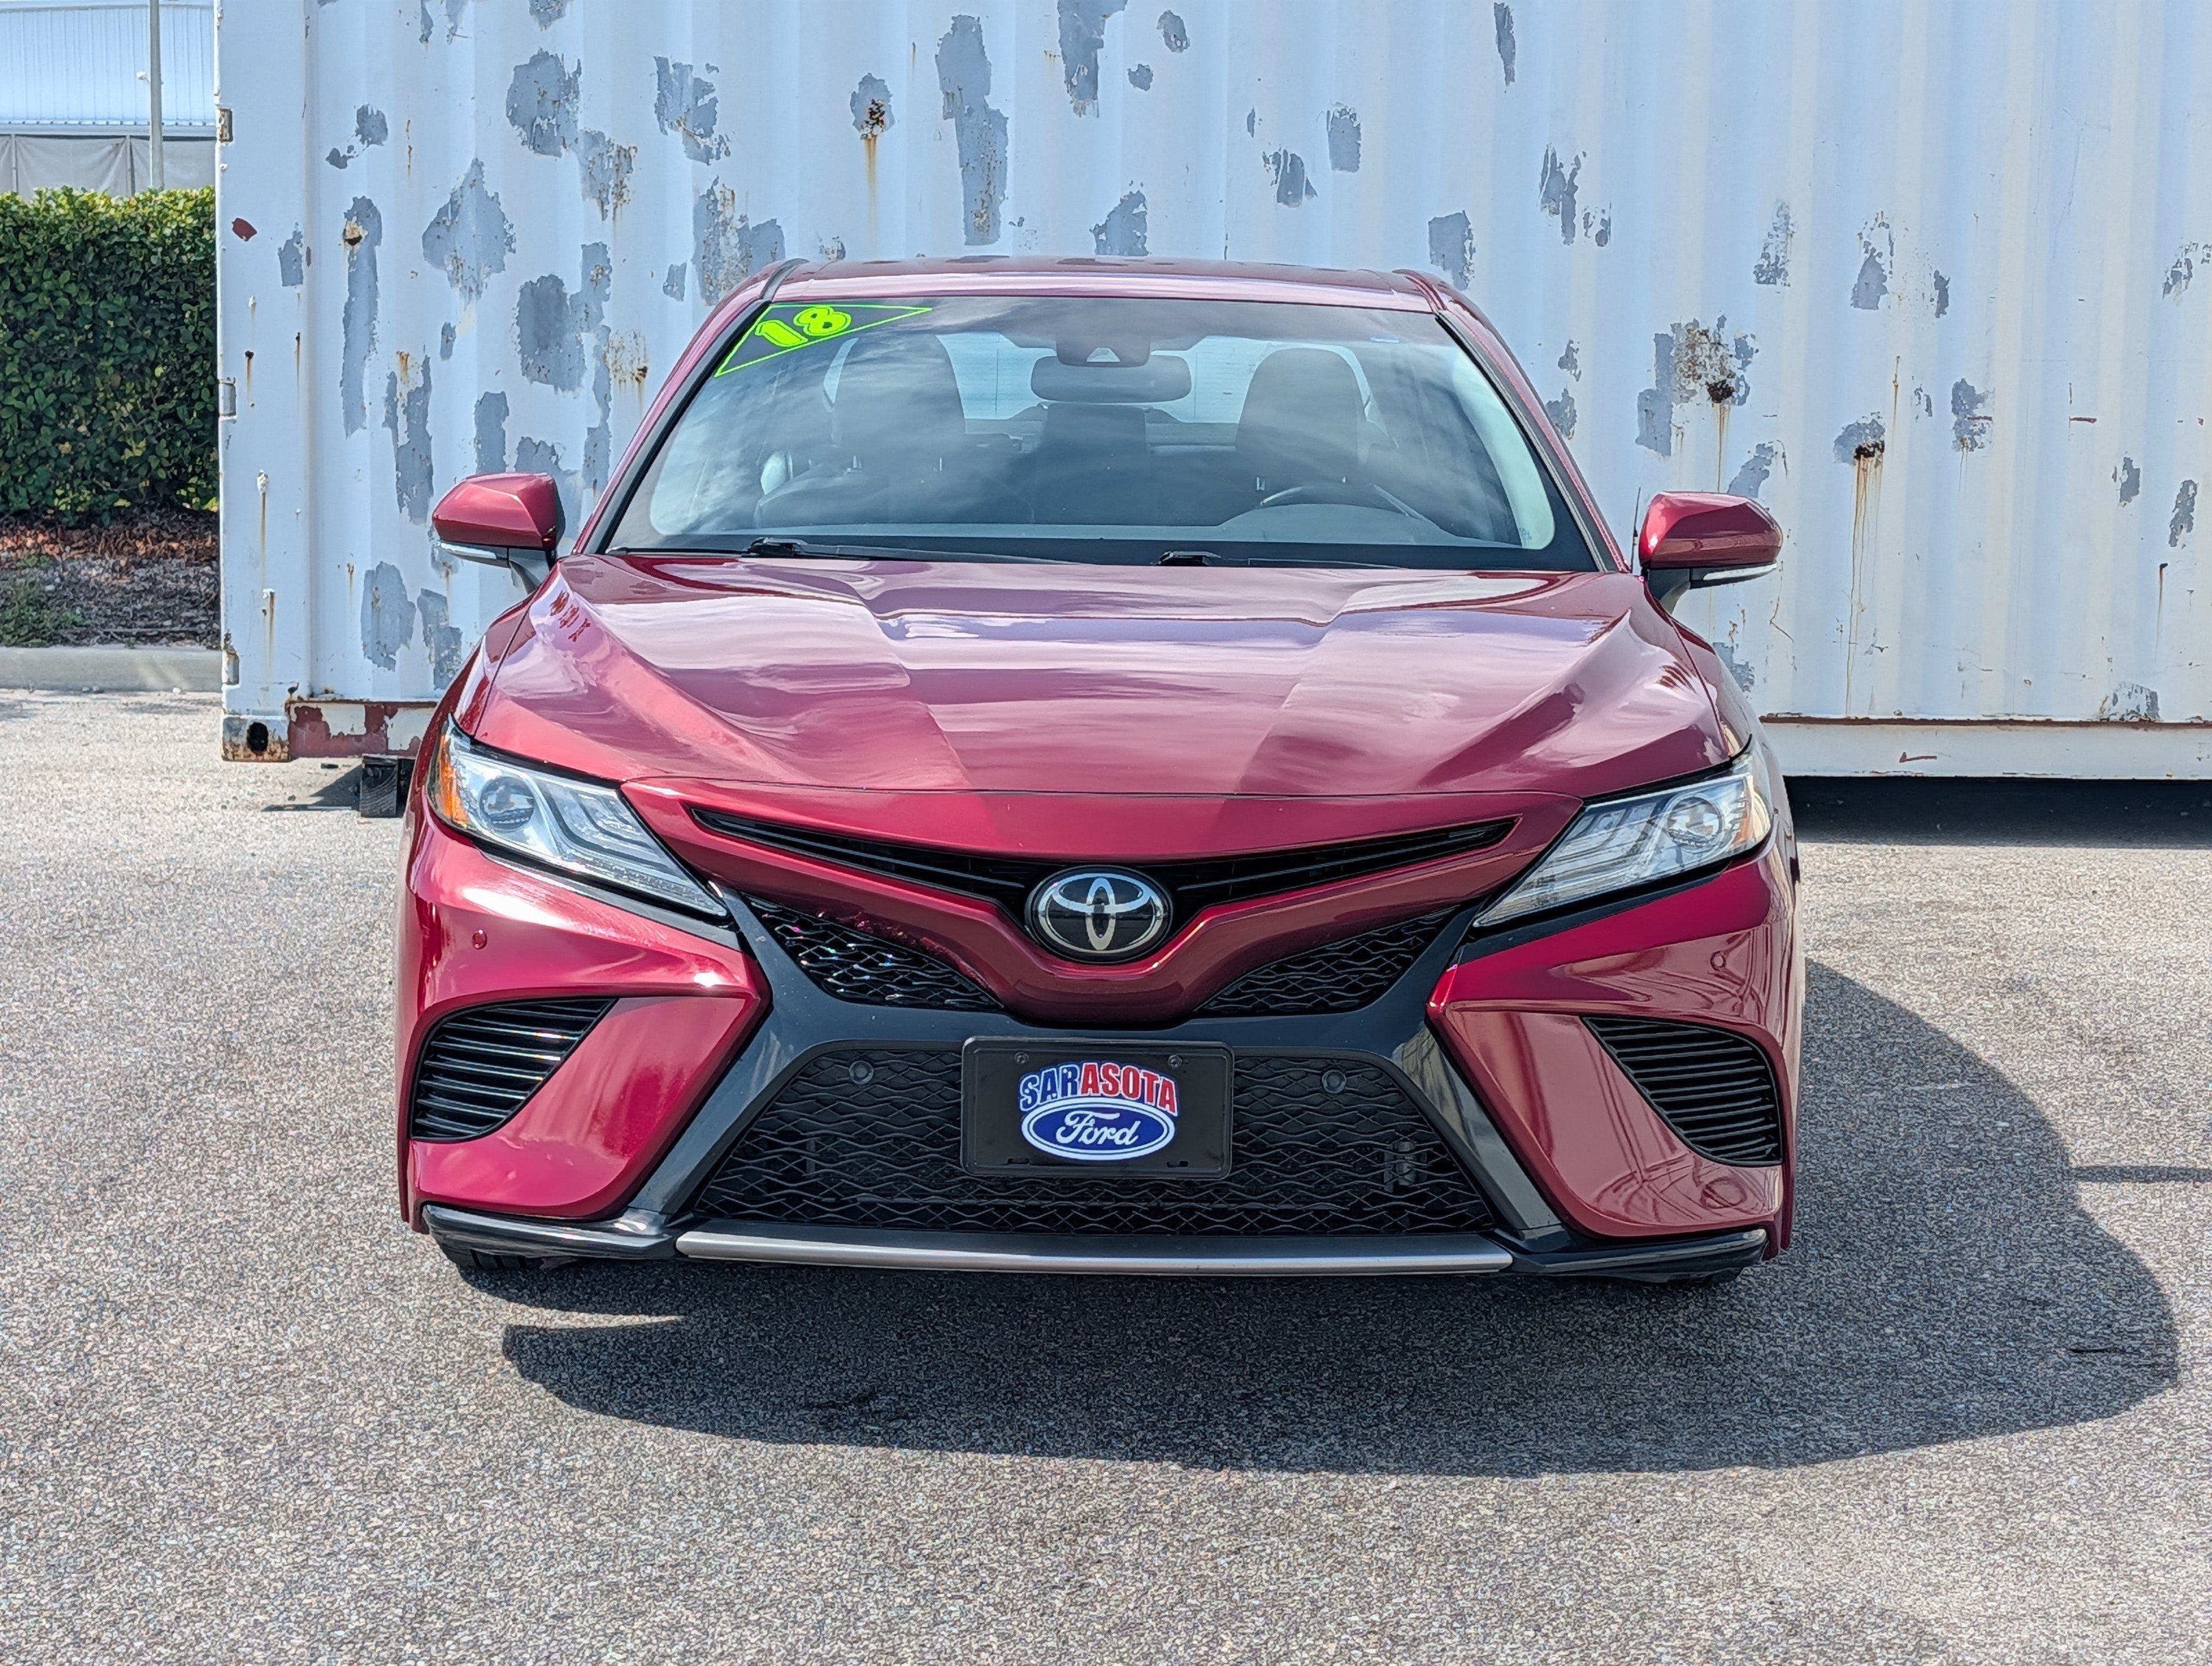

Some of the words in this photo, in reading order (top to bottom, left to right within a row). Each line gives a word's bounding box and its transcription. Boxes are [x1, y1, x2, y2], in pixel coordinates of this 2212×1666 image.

[755, 306, 852, 347] 18
[1020, 1062, 1178, 1116] SARASOTA
[1056, 1111, 1141, 1145] Ford
